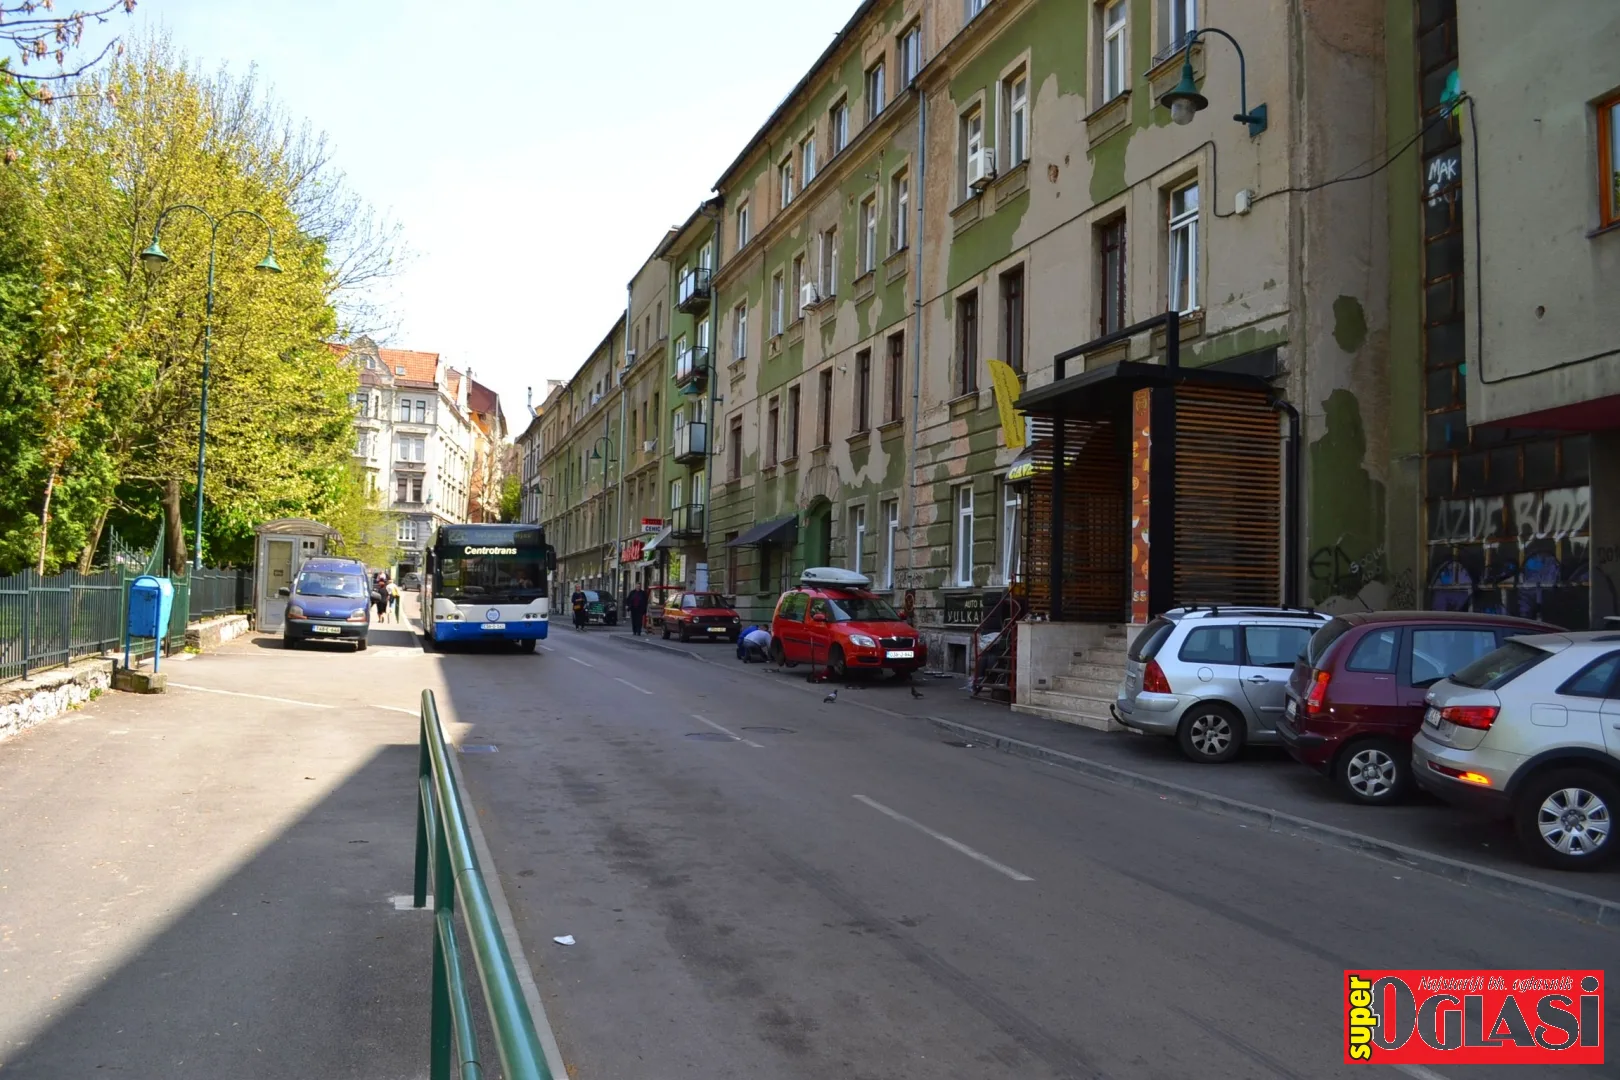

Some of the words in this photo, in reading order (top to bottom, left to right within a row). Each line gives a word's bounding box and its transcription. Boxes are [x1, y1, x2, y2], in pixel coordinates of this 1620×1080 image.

[1428, 158, 1457, 183] MAK
[464, 546, 517, 555] Centrotrans
[964, 599, 978, 608] AUTO
